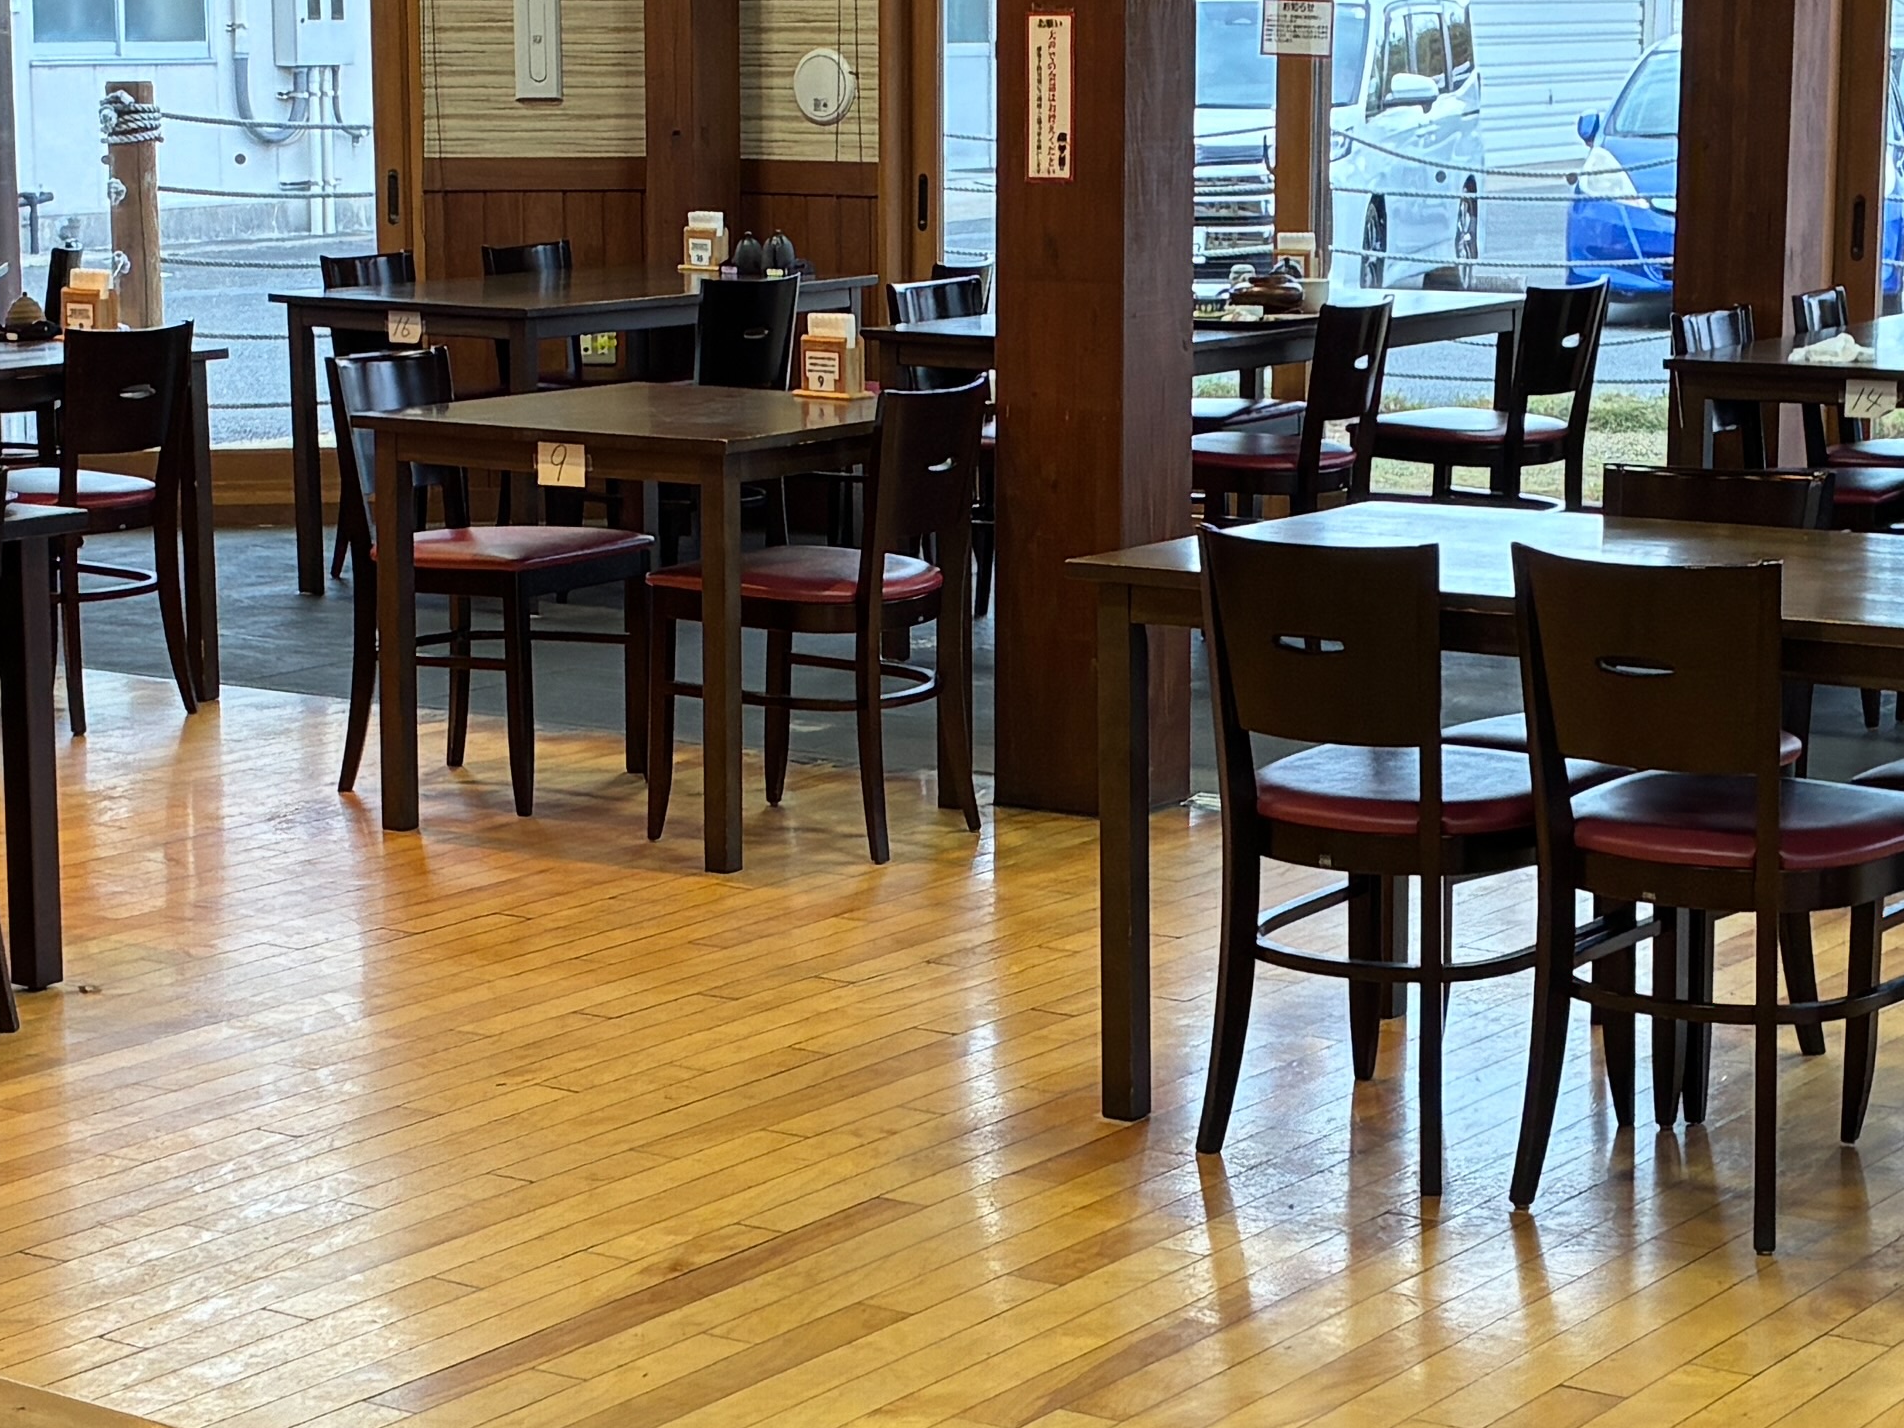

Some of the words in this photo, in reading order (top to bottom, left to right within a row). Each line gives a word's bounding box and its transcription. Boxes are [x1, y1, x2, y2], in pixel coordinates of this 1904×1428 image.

[392, 316, 411, 339] 16
[817, 375, 825, 389] 9
[1851, 386, 1884, 413] 14
[550, 444, 568, 483] 9
